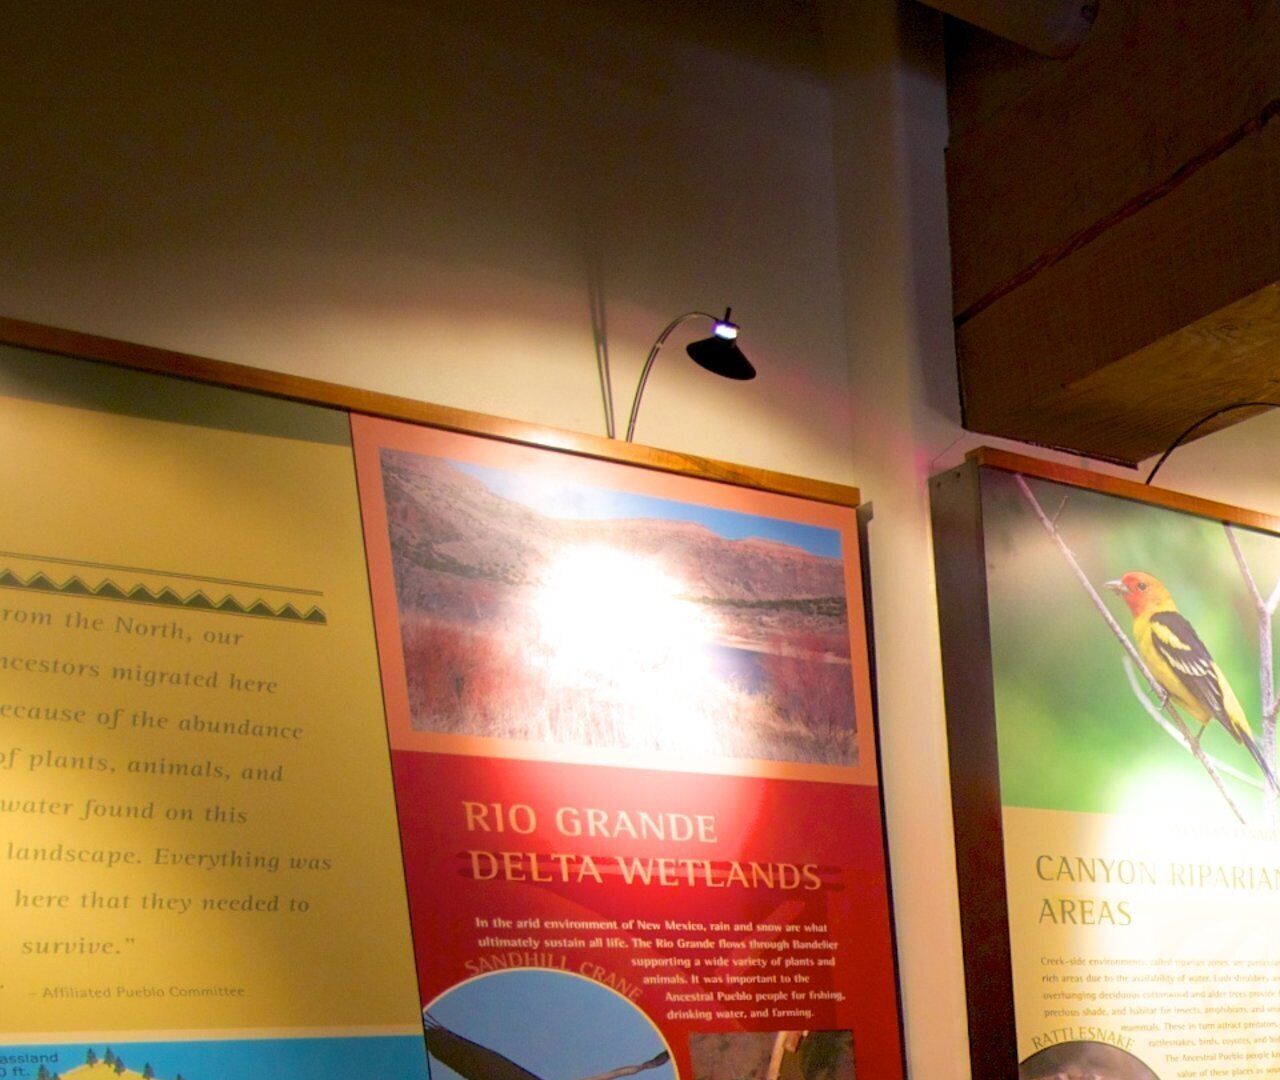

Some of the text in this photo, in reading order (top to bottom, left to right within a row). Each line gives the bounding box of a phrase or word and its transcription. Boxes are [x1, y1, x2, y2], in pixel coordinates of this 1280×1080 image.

[65, 611, 103, 631] the
[114, 616, 191, 642] North,
[203, 630, 243, 645] our
[112, 667, 217, 688] migrated
[229, 672, 277, 693] here
[96, 708, 124, 729] of
[131, 710, 168, 729] the
[178, 714, 302, 739] abundance
[0, 748, 282, 781] of plants, animals, and
[0, 799, 246, 823] water found on this
[463, 801, 717, 843] RIO GRANDE
[8, 842, 331, 872] landscape. Everything was
[468, 850, 822, 890] DELTA WETLANDS
[1035, 854, 1158, 886] CANYON
[15, 889, 309, 913] here that they needed to
[1038, 898, 1132, 926] AREAS
[475, 917, 488, 927] In
[492, 917, 512, 927] the
[516, 918, 540, 928] arid
[543, 919, 617, 929] environment
[621, 919, 634, 929] of
[636, 919, 660, 929] New
[664, 920, 706, 931] Mexico,
[709, 921, 730, 930] rain
[733, 922, 752, 931] and
[785, 924, 800, 932] are
[803, 923, 827, 932] what
[464, 952, 642, 999] SANDHILL CRANE
[631, 956, 835, 968] supporting a wide variety of plants and
[42, 986, 111, 998] Affiliated
[116, 985, 164, 997] Pueblo
[168, 986, 244, 997] Committee
[1031, 1025, 1135, 1051] RATTLESNAKE
[12, 1066, 31, 1077] ft.
